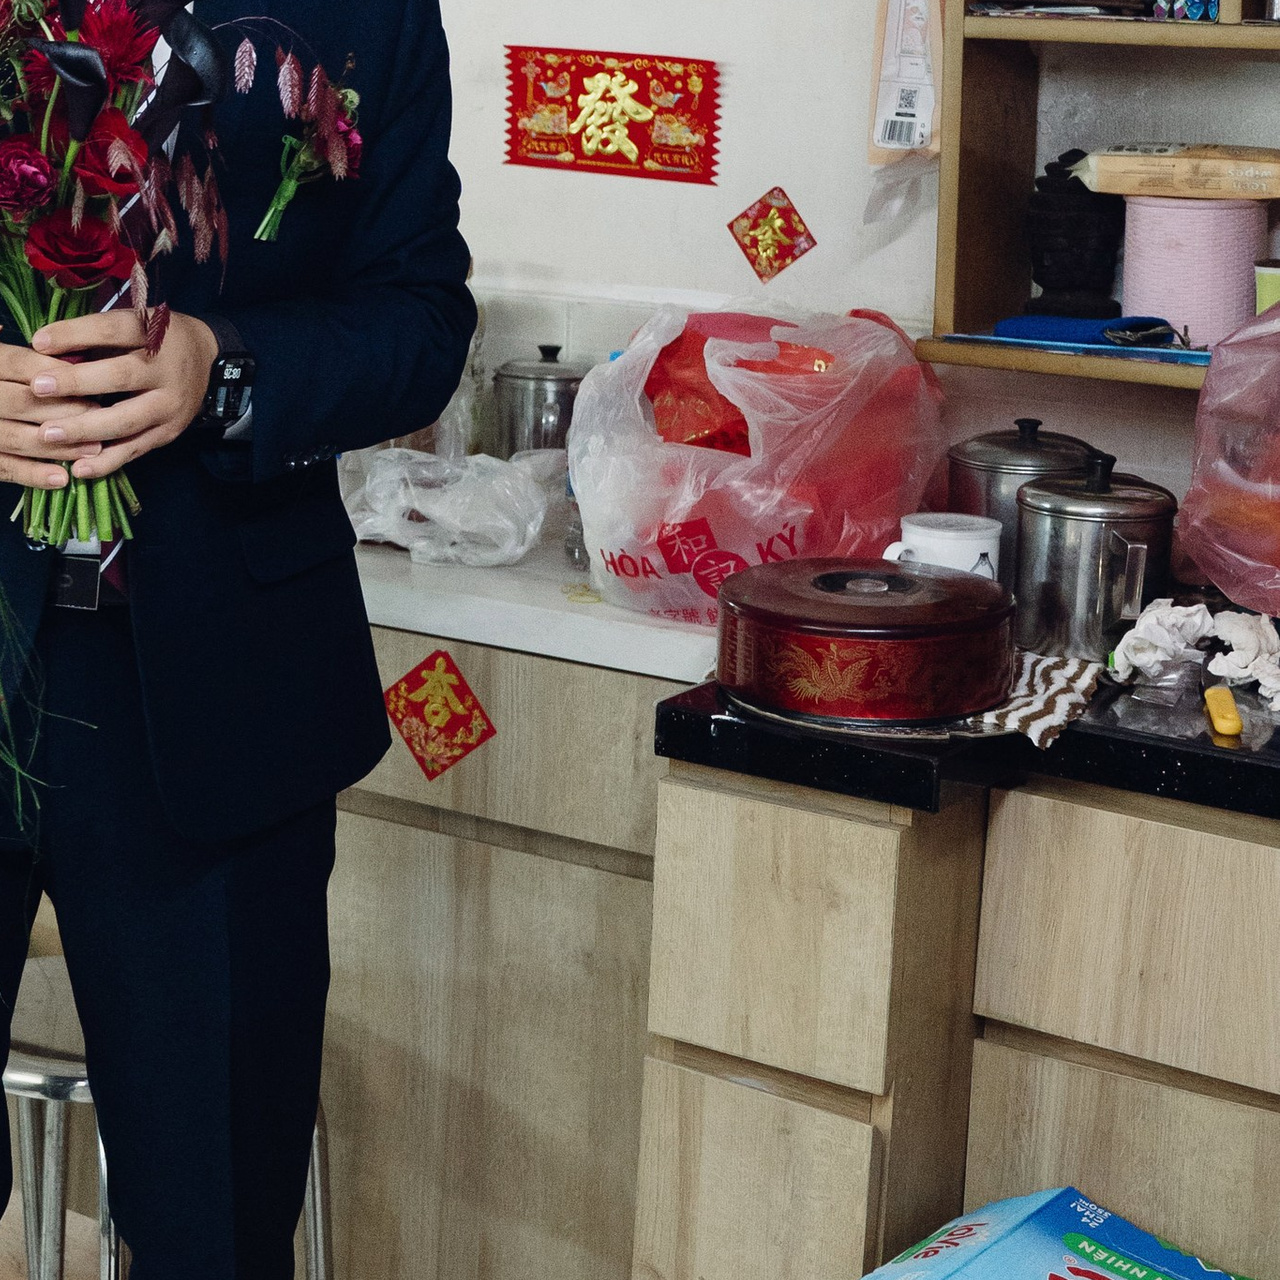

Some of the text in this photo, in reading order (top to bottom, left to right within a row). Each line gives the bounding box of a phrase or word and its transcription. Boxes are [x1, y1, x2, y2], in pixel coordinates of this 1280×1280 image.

[600, 521, 799, 581] HÒA KÝ
[1069, 1202, 1104, 1224] CHAI
[1081, 1216, 1099, 1228] 24
[913, 1222, 988, 1259] laVie
[1078, 1240, 1147, 1279] NHIÊN
